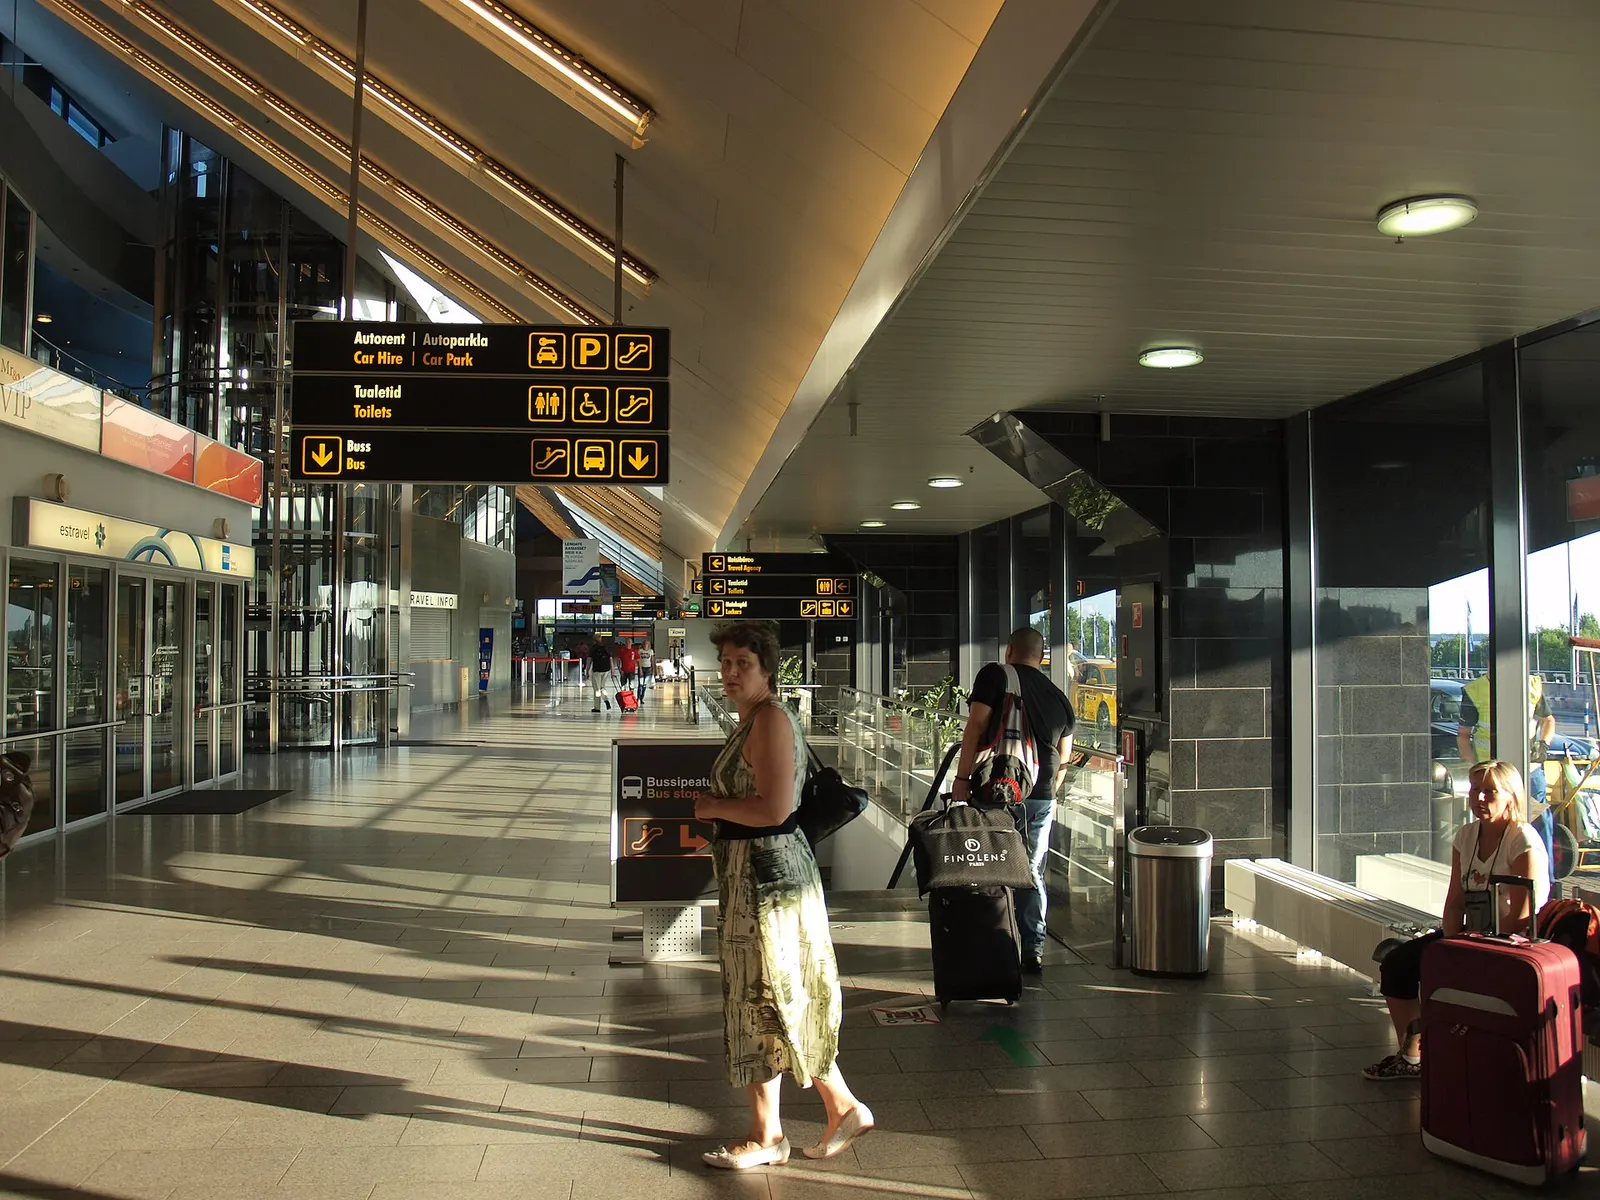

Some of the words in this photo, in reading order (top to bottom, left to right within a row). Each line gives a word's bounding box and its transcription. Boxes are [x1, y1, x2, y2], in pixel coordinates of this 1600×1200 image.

[354, 331, 406, 345] Autorent
[422, 333, 489, 349] Autoparkla
[580, 338, 601, 365] P
[353, 351, 375, 364] Car
[377, 351, 403, 365] Hire
[422, 352, 443, 366] Car
[446, 352, 473, 367] Park
[354, 385, 402, 399] Tualetid
[0, 382, 32, 420] VIP
[353, 404, 392, 419] Toilets
[347, 439, 372, 453] Buss
[346, 457, 365, 470] Bus
[60, 525, 90, 540] estravel
[410, 594, 434, 605] RAVEL
[437, 596, 454, 607] INFO
[647, 777, 712, 788] Bussipeatu
[646, 788, 670, 799] Bus
[673, 790, 700, 800] stop
[944, 853, 1006, 863] FINOLENS
